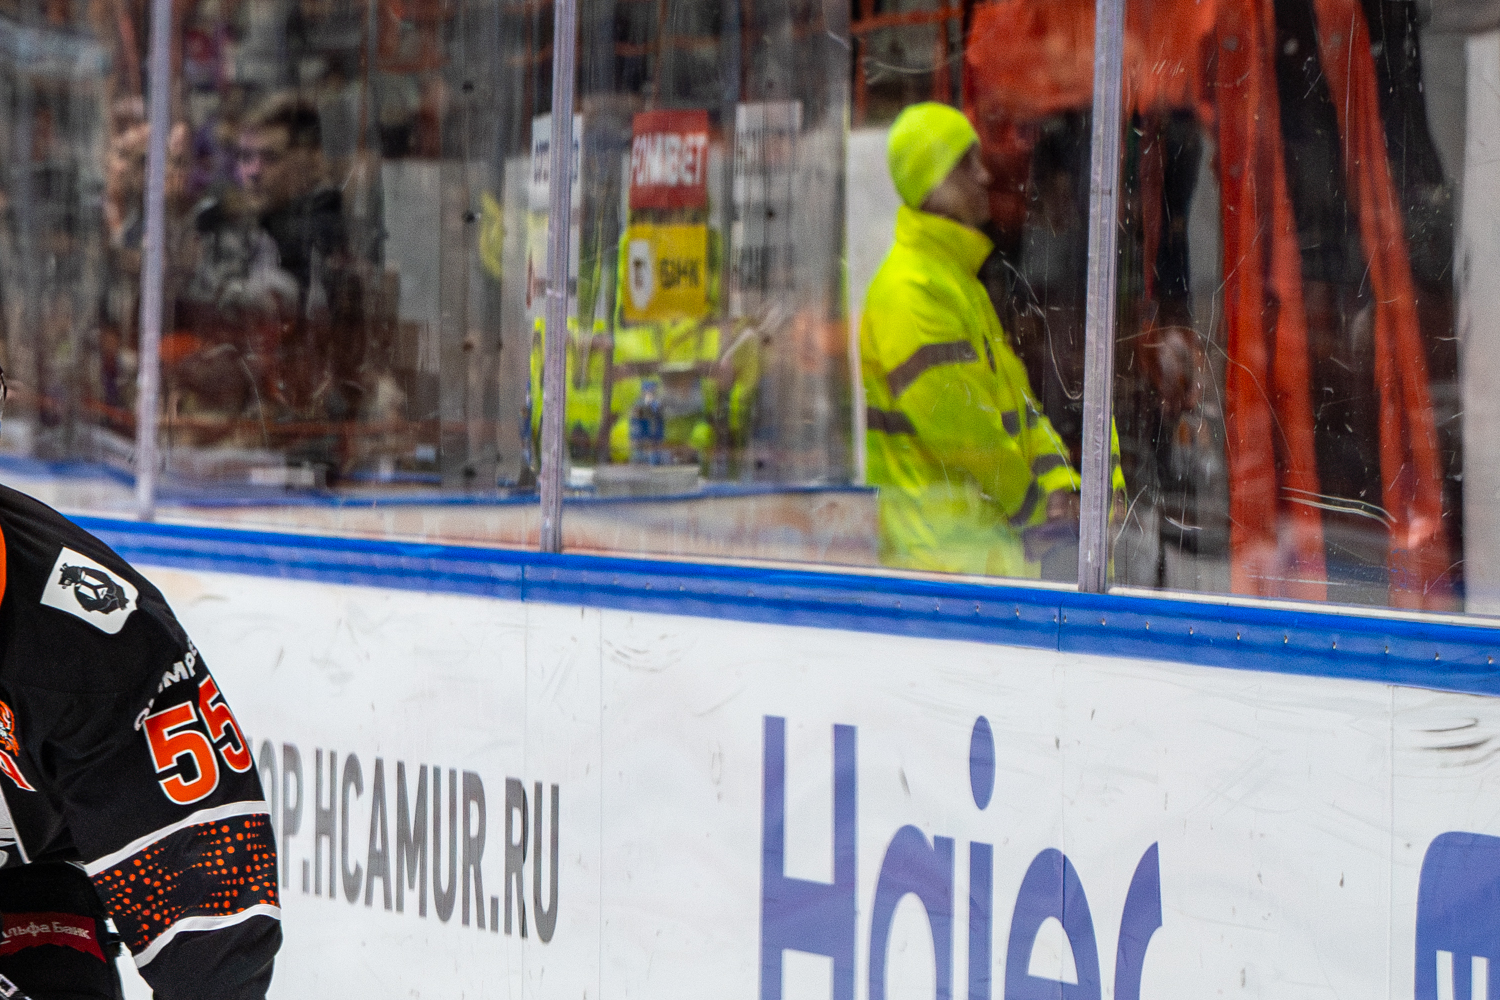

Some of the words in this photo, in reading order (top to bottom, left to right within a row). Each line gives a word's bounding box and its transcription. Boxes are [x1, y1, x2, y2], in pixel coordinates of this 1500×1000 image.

[142, 674, 252, 806] 55
[249, 738, 560, 944] OP.HCAMUR.RU
[52, 921, 92, 940] Банк
